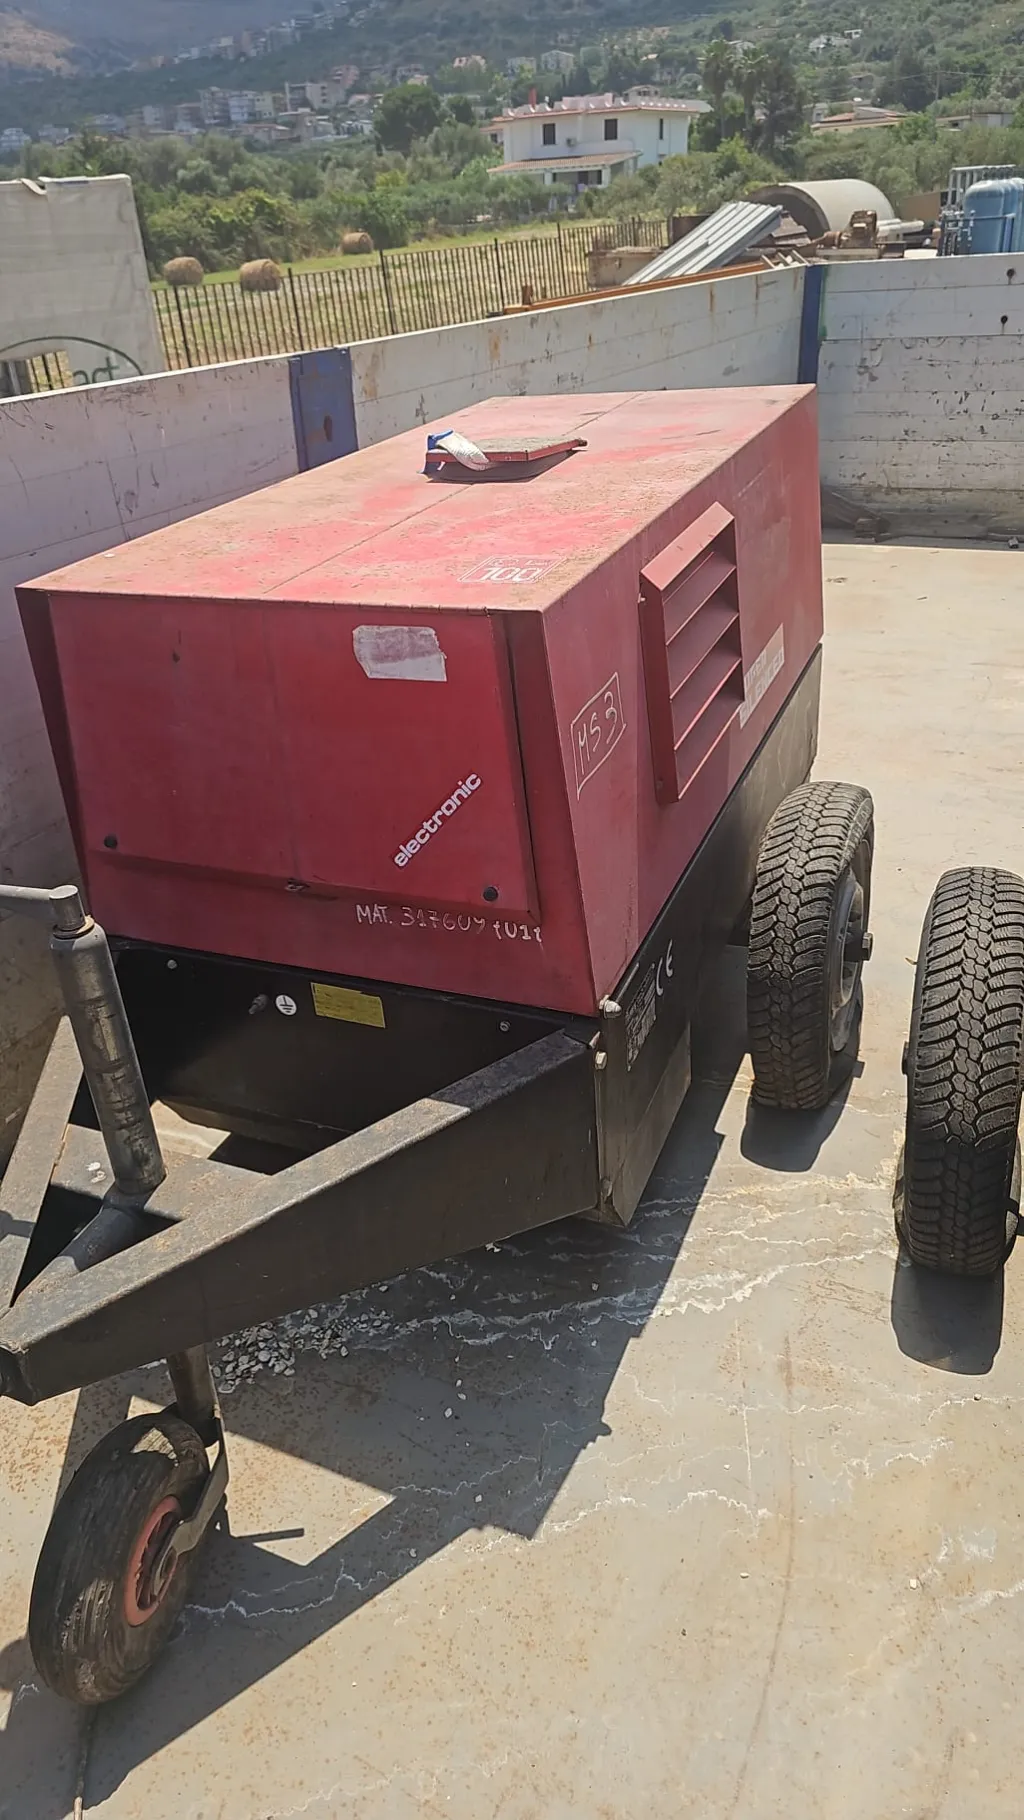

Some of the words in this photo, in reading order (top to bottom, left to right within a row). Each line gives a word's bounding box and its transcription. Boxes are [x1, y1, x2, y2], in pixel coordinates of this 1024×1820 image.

[479, 567, 543, 582] 100
[394, 773, 482, 867] electronic
[356, 903, 393, 925] MAT.
[656, 939, 673, 996] CE
